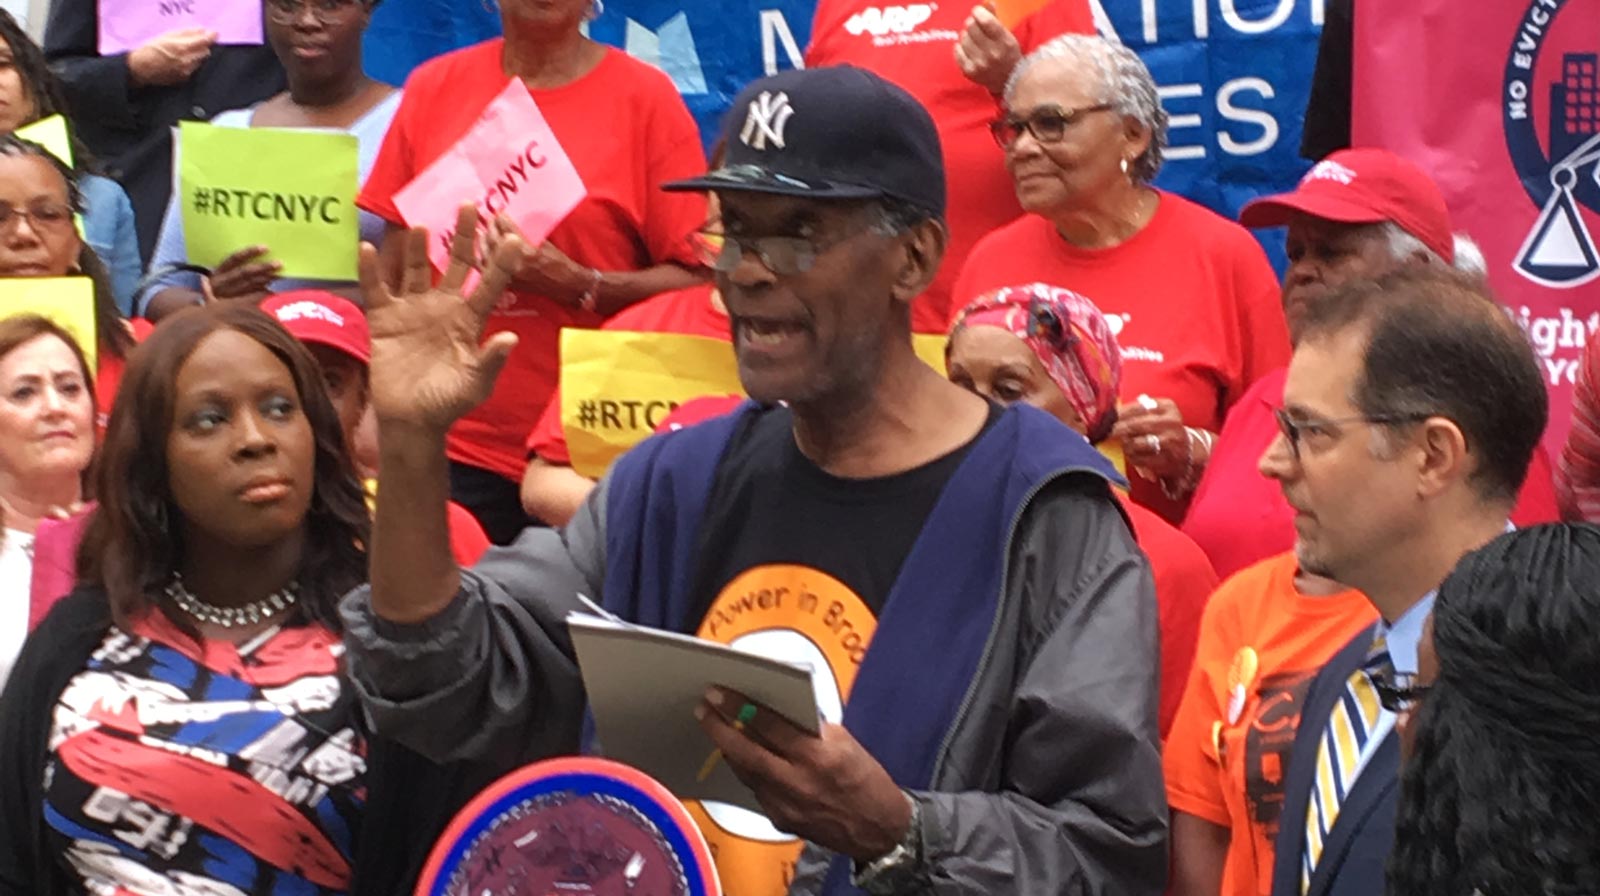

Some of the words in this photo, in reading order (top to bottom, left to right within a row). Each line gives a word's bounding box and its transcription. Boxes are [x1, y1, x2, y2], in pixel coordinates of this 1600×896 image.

[158, 0, 195, 16] NYC
[1508, 79, 1528, 120] NO
[740, 90, 795, 151] NY
[194, 186, 341, 225] #RTCNYC
[578, 400, 680, 431] #RTC
[798, 583, 819, 614] in
